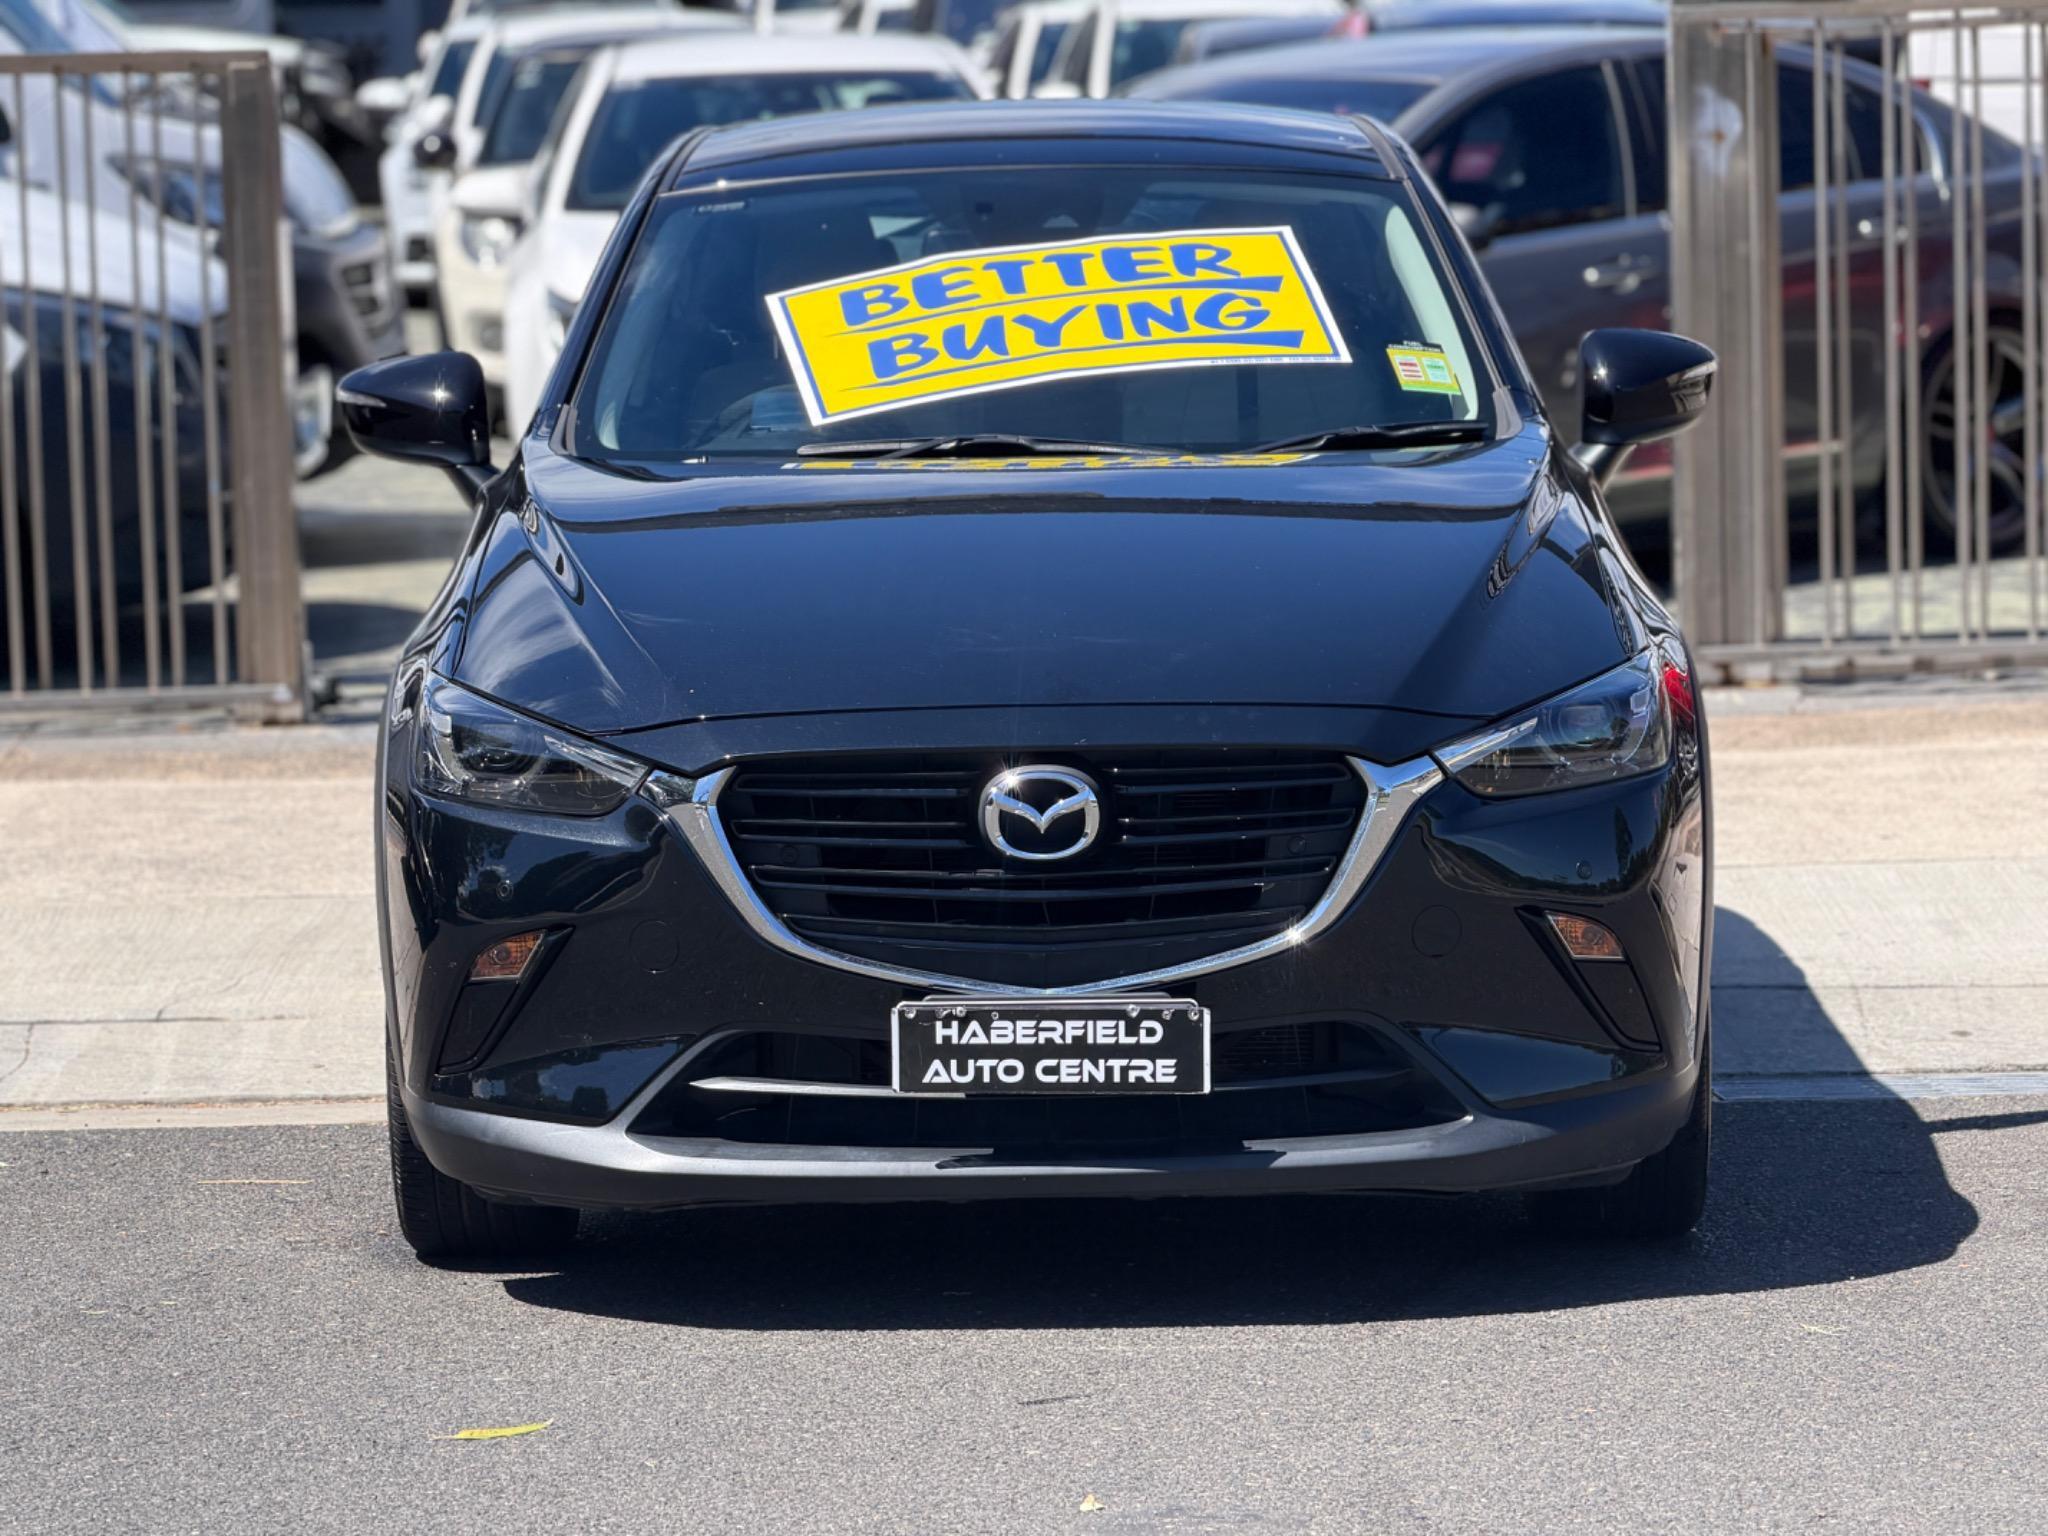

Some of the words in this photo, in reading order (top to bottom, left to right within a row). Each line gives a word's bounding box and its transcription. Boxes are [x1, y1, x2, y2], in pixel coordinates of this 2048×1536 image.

[838, 242, 1242, 328] BETTER
[866, 292, 1272, 380] BUYING
[935, 1020, 1164, 1045] HABERFIELD
[922, 1059, 1025, 1084] AUTO
[1035, 1059, 1178, 1084] CENTRE
